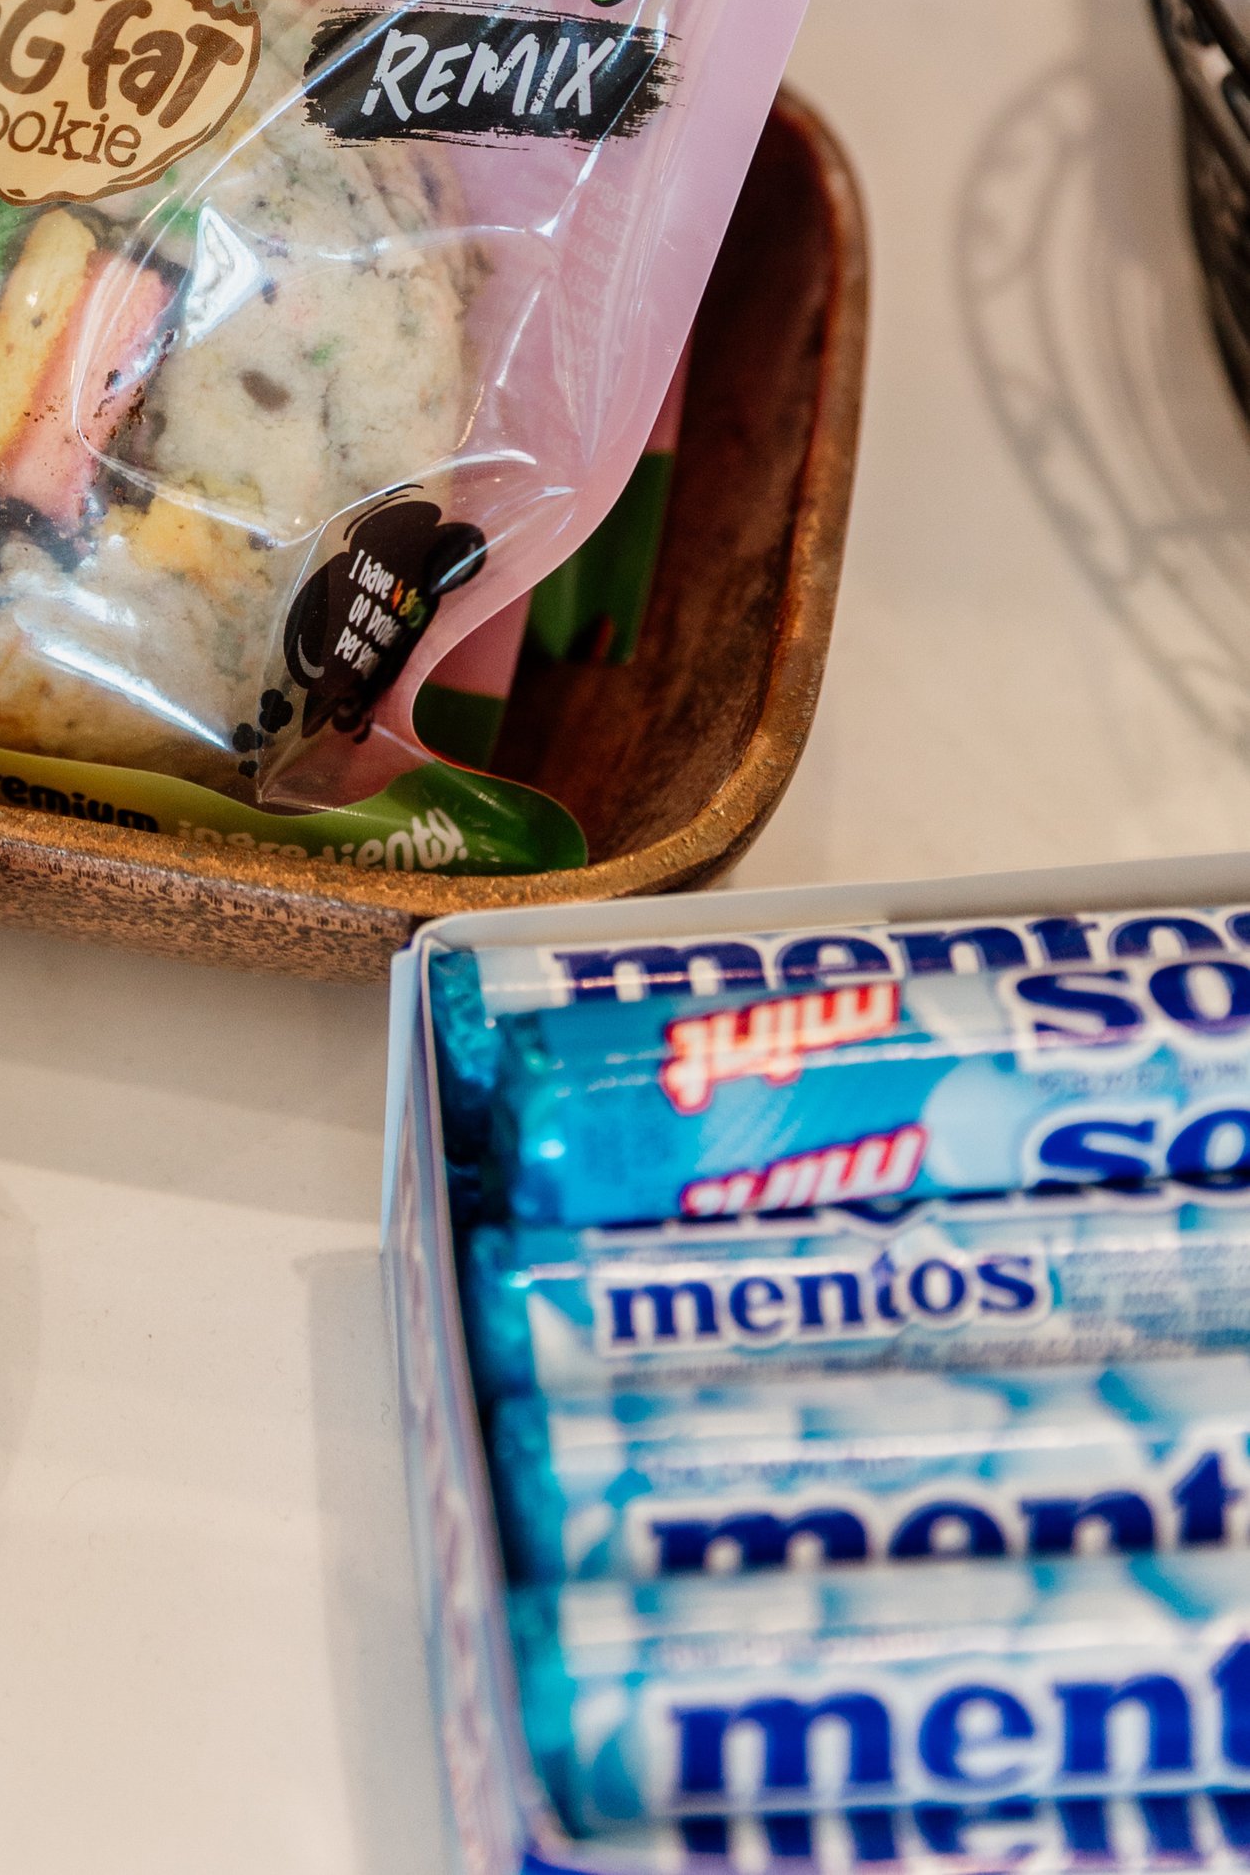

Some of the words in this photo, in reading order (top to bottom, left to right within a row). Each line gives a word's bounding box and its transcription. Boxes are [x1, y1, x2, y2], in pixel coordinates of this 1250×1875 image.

[360, 27, 617, 123] REMIX
[348, 548, 365, 580] I
[357, 554, 395, 601] have
[333, 625, 363, 662] per
[606, 1250, 1038, 1342] mentos
